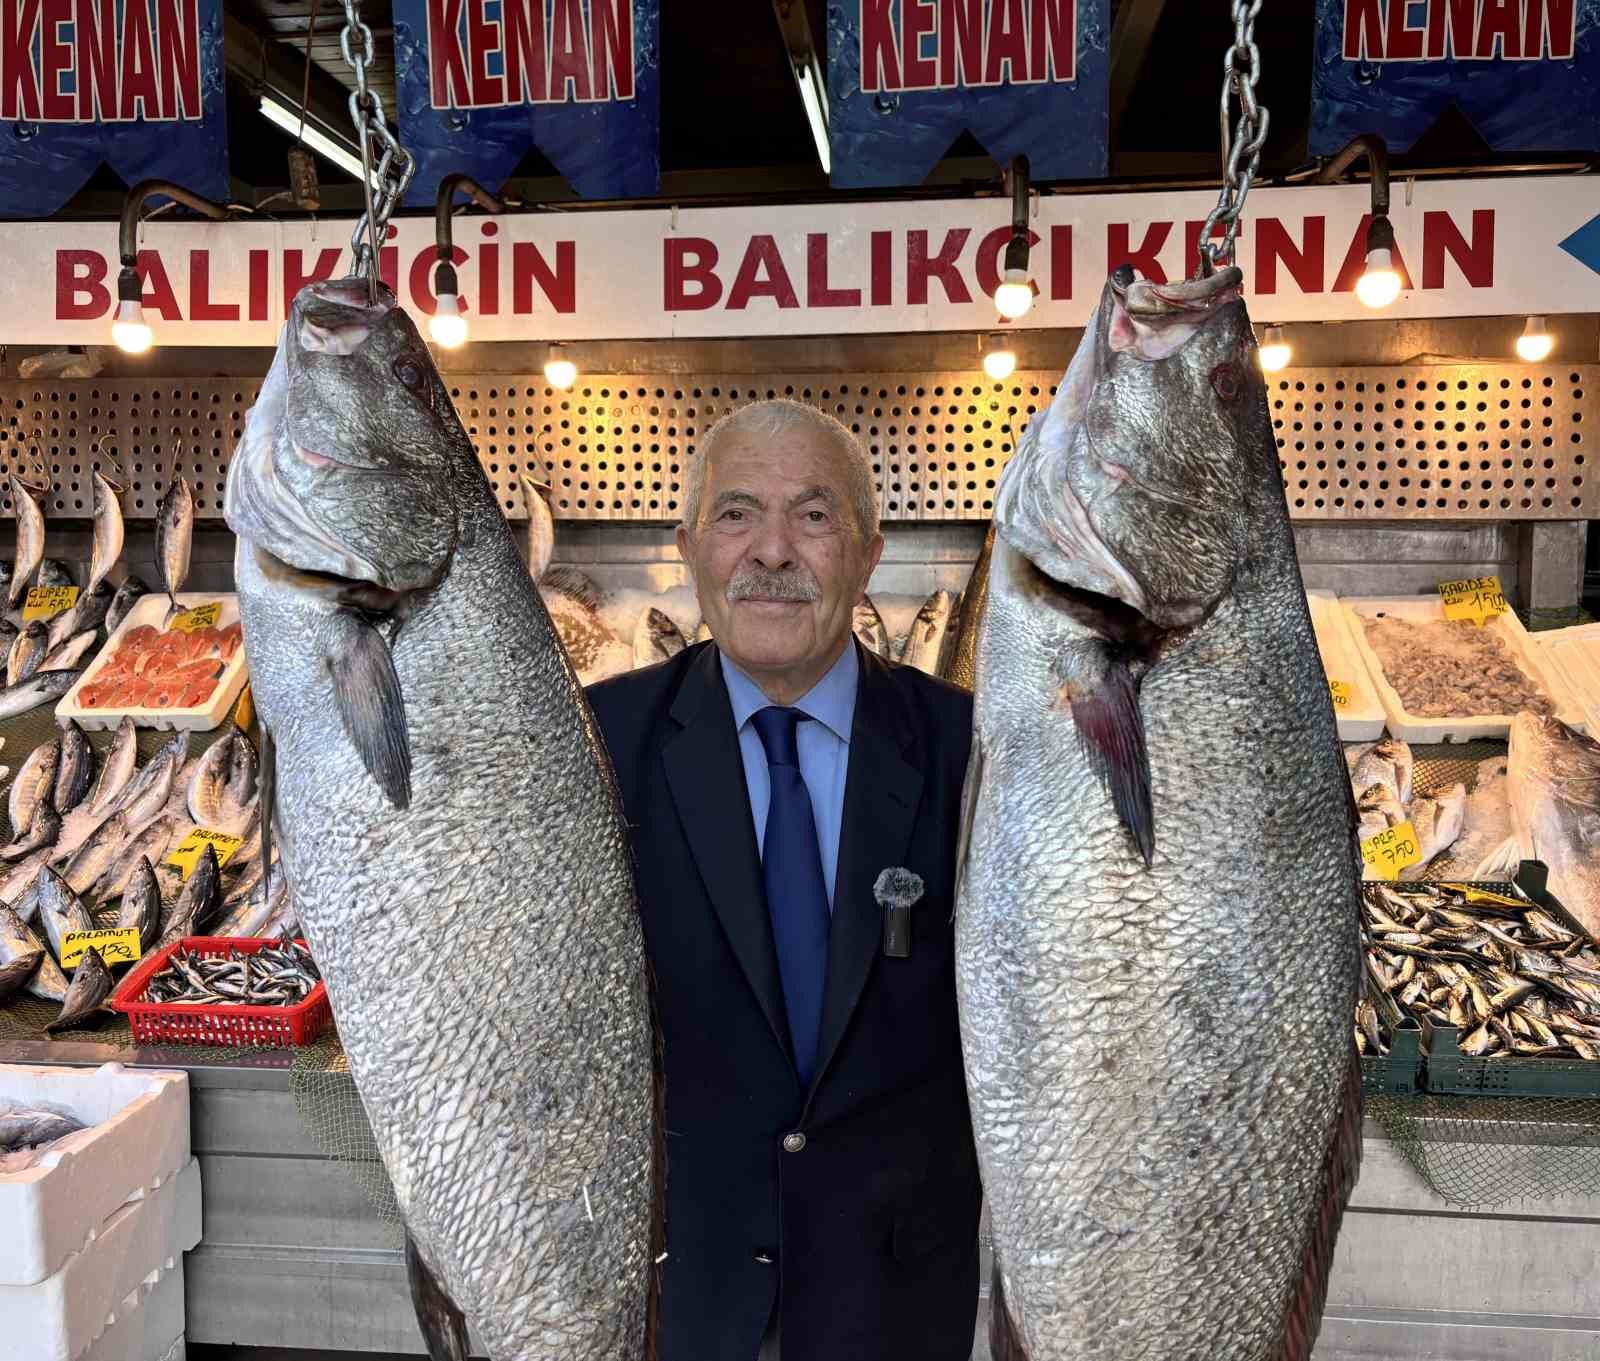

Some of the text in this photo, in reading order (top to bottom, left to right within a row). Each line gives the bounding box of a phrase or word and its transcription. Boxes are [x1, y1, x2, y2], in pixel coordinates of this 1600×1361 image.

[0, 0, 202, 122] KENAN
[425, 0, 636, 110] KENAN
[859, 0, 1077, 93] KENAN
[56, 247, 343, 321] BALIK
[65, 929, 134, 944] PALAMUT
